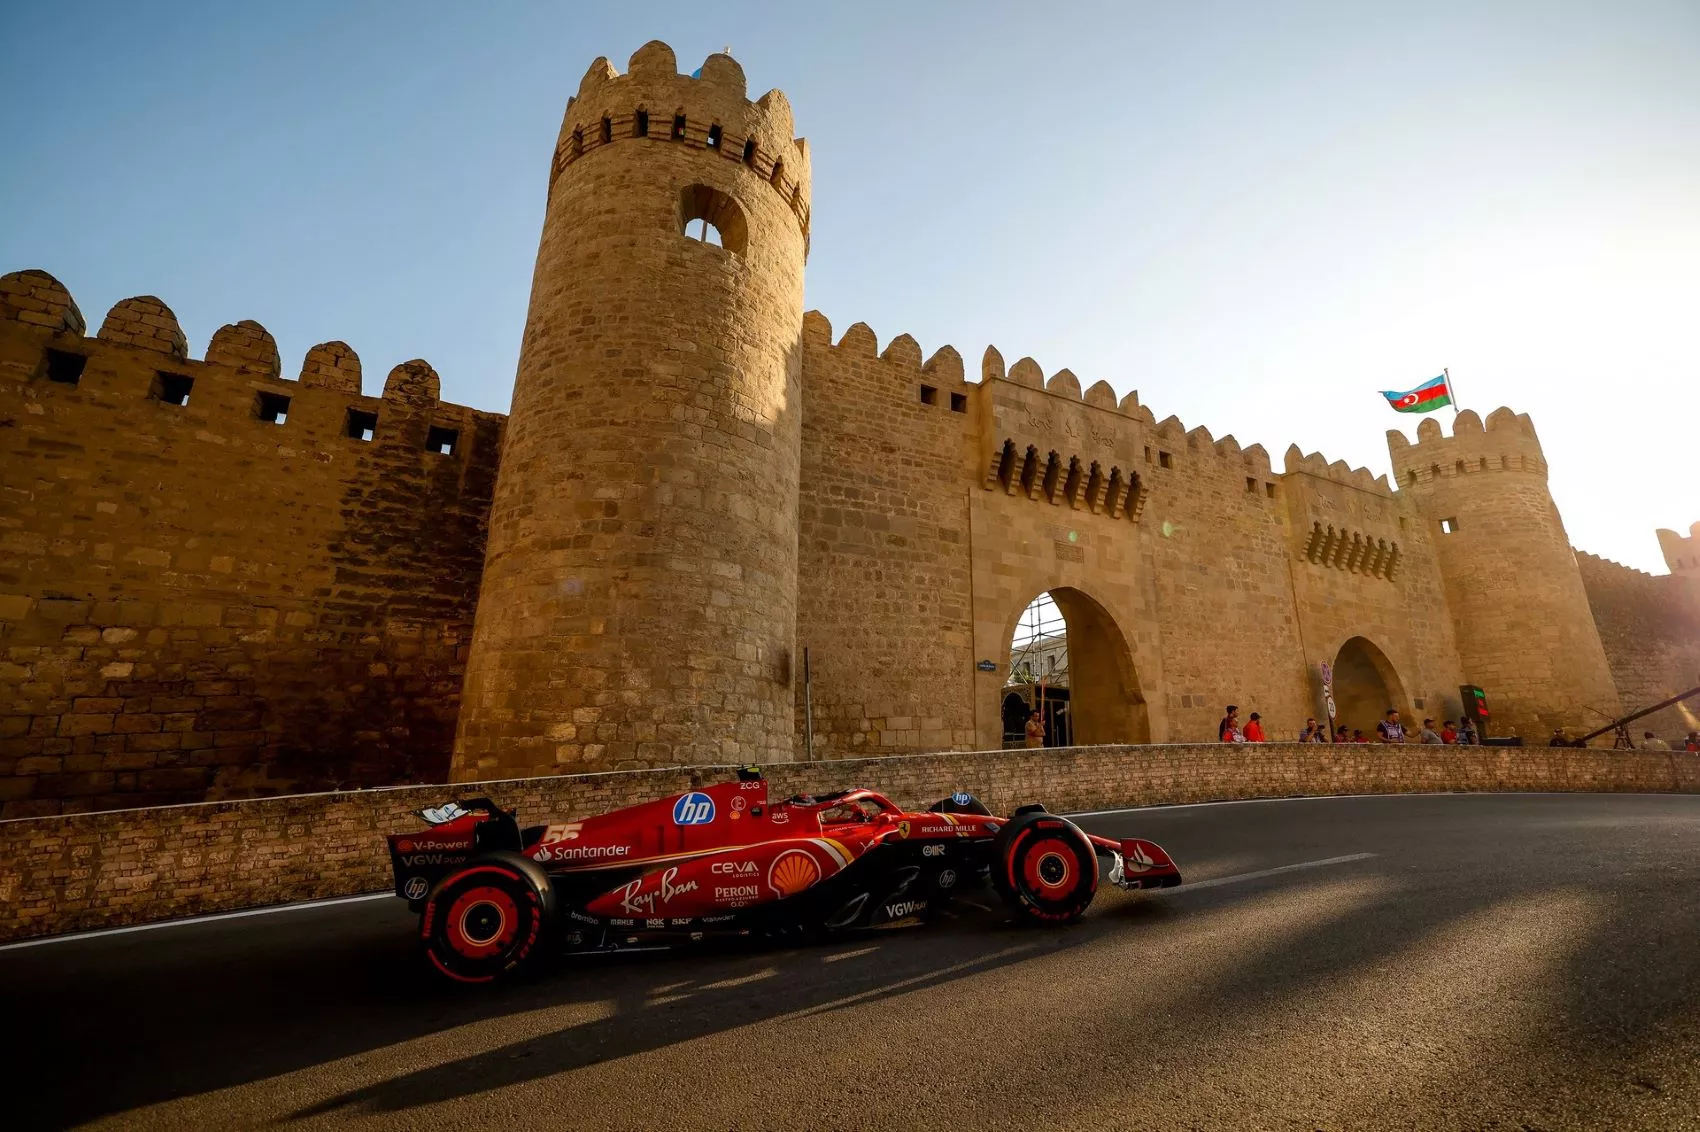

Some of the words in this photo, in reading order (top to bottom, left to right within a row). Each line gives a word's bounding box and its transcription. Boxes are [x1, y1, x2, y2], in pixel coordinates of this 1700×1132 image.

[740, 781, 760, 790] ZCG
[955, 793, 968, 805] hp
[679, 793, 710, 824] hp
[541, 823, 584, 846] 55
[413, 841, 469, 851] V-Power
[554, 845, 631, 861] Santander
[400, 854, 442, 868] VGW
[940, 869, 955, 888] hp
[408, 877, 426, 899] hp
[714, 885, 758, 898] PERONI
[885, 900, 915, 919] VGW
[571, 910, 600, 925] brembo
[610, 918, 634, 926] MAHLE
[646, 918, 665, 926] NGK
[671, 918, 691, 926] SKF
